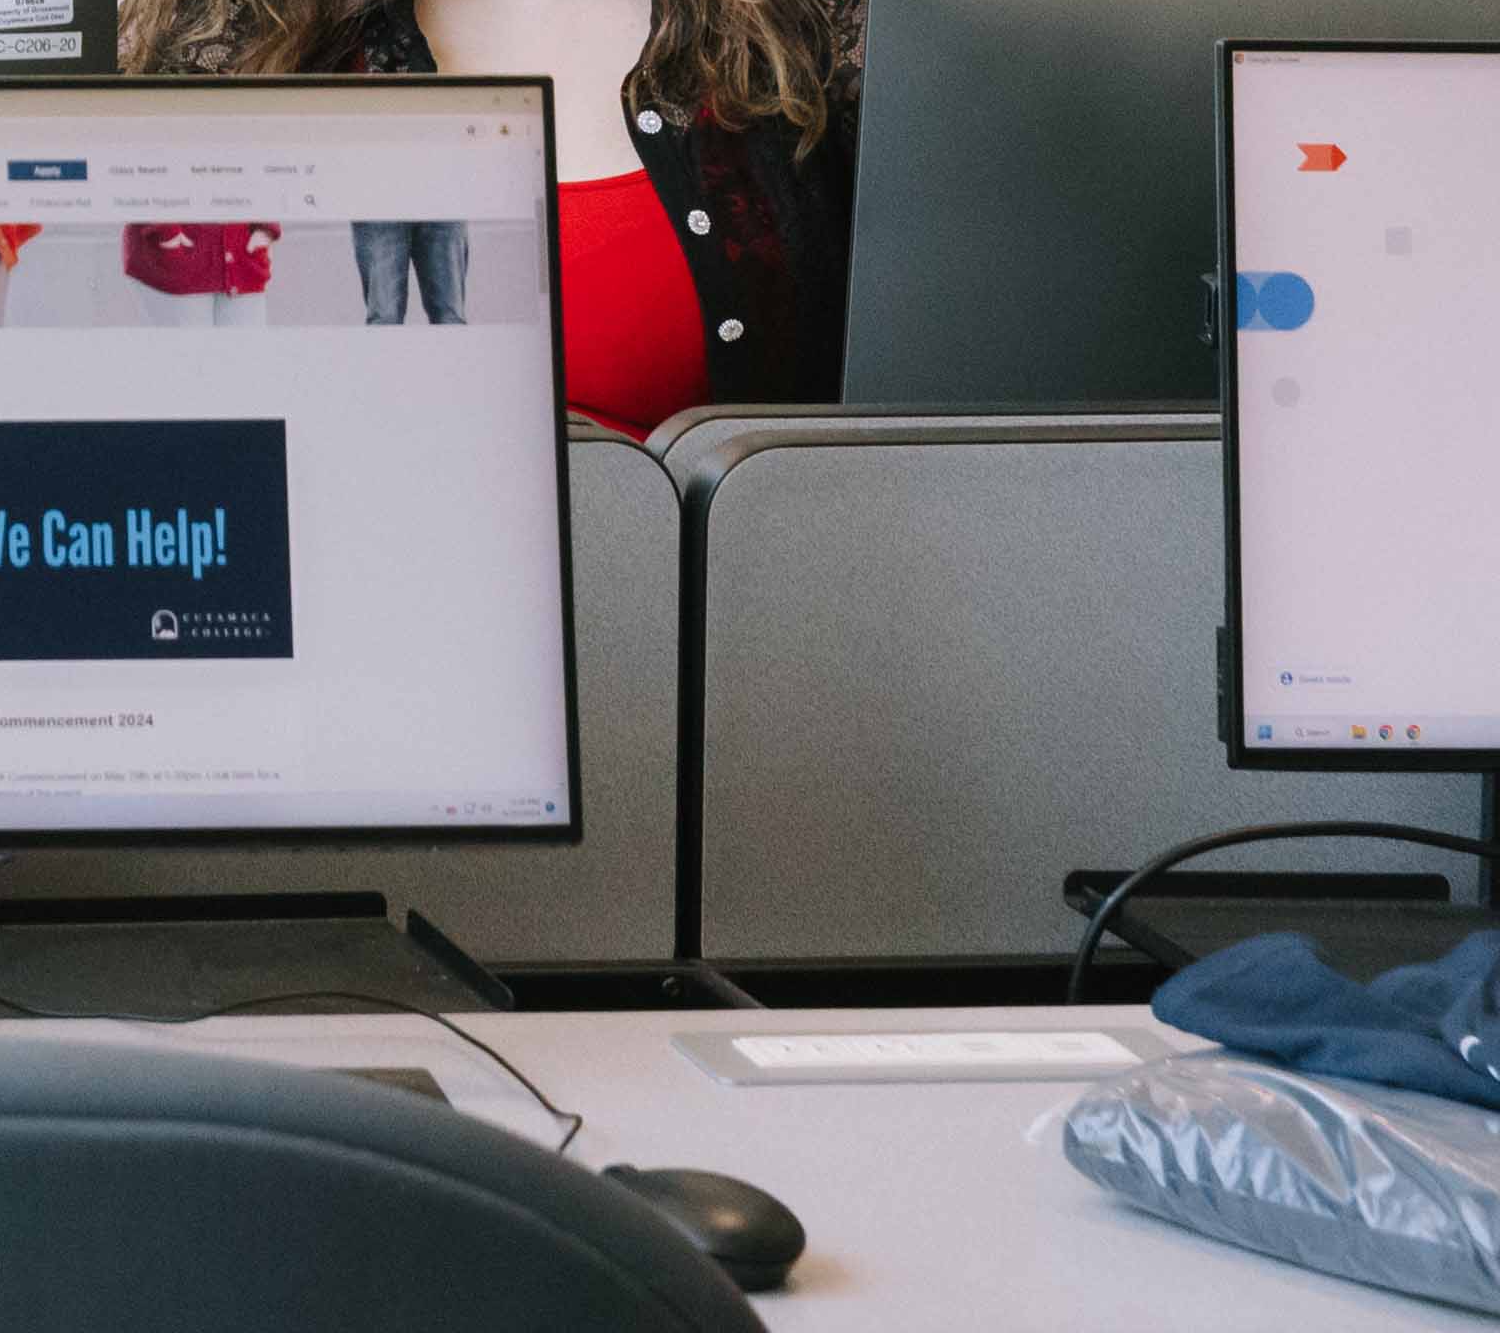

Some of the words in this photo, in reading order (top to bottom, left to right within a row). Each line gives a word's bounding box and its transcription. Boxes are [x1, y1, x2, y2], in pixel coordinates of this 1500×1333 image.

[41, 508, 115, 569] Can
[125, 506, 229, 581] Help!
[117, 713, 155, 728] 2024
